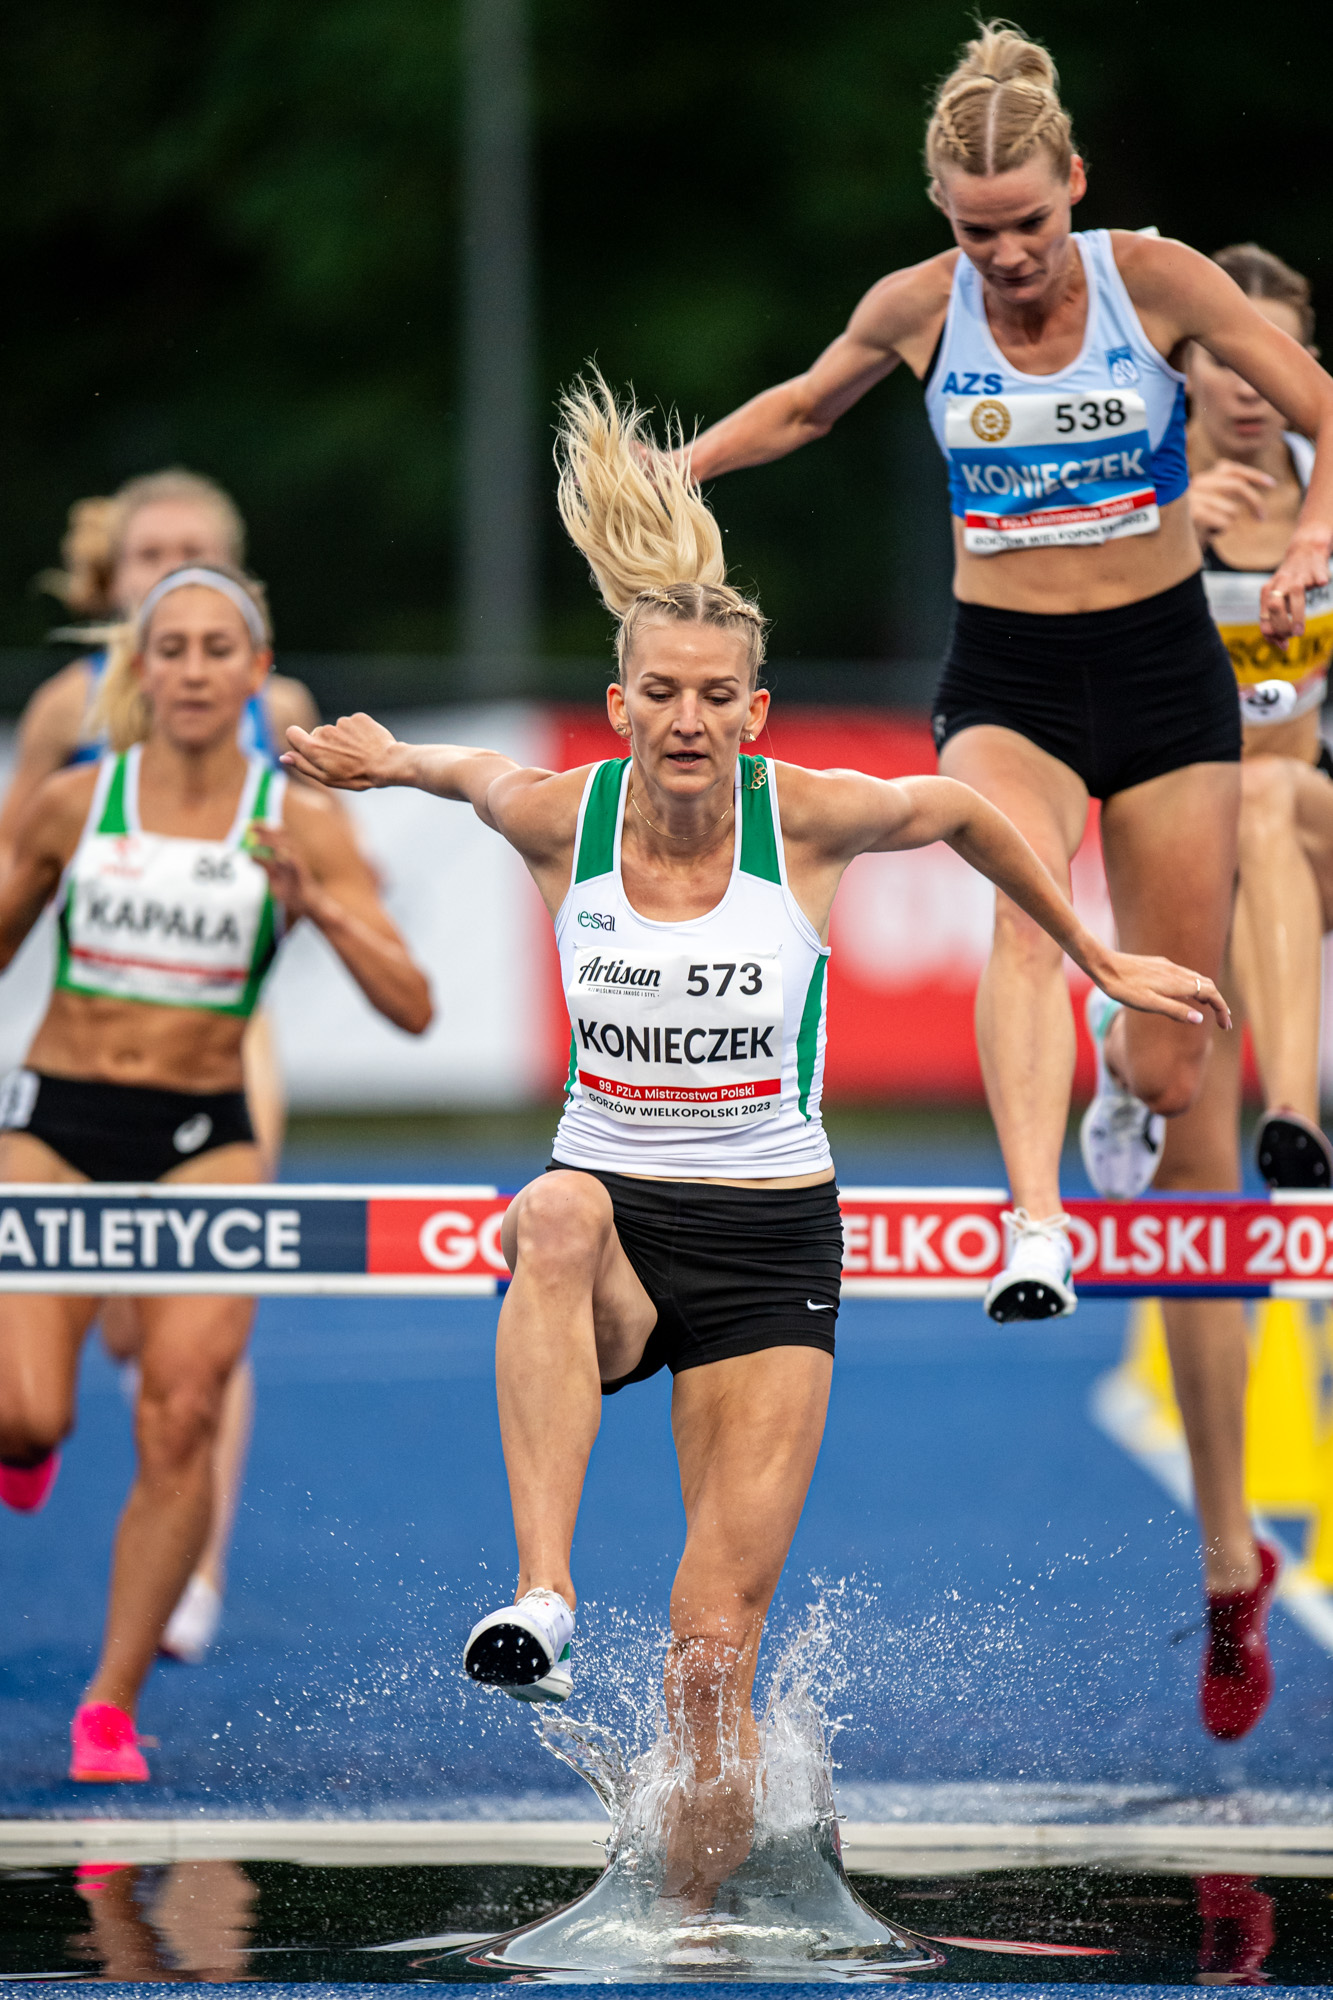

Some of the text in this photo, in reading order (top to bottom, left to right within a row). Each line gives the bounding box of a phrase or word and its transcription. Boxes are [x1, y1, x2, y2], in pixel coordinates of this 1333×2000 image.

[942, 371, 1003, 395] AZS
[1056, 399, 1127, 433] 538
[961, 448, 1146, 499] KONIECZEK
[578, 956, 660, 987] Artisan
[686, 962, 762, 997] 573
[578, 1018, 775, 1065] KONIECZEK
[589, 1093, 771, 1118] GORZÓW WIELKOPOLSKI 2023
[599, 1079, 755, 1101] 99. PZLA Mistrzostwa Polski
[0, 1207, 301, 1269] ATLETYCE
[1244, 1214, 1333, 1276] 20
